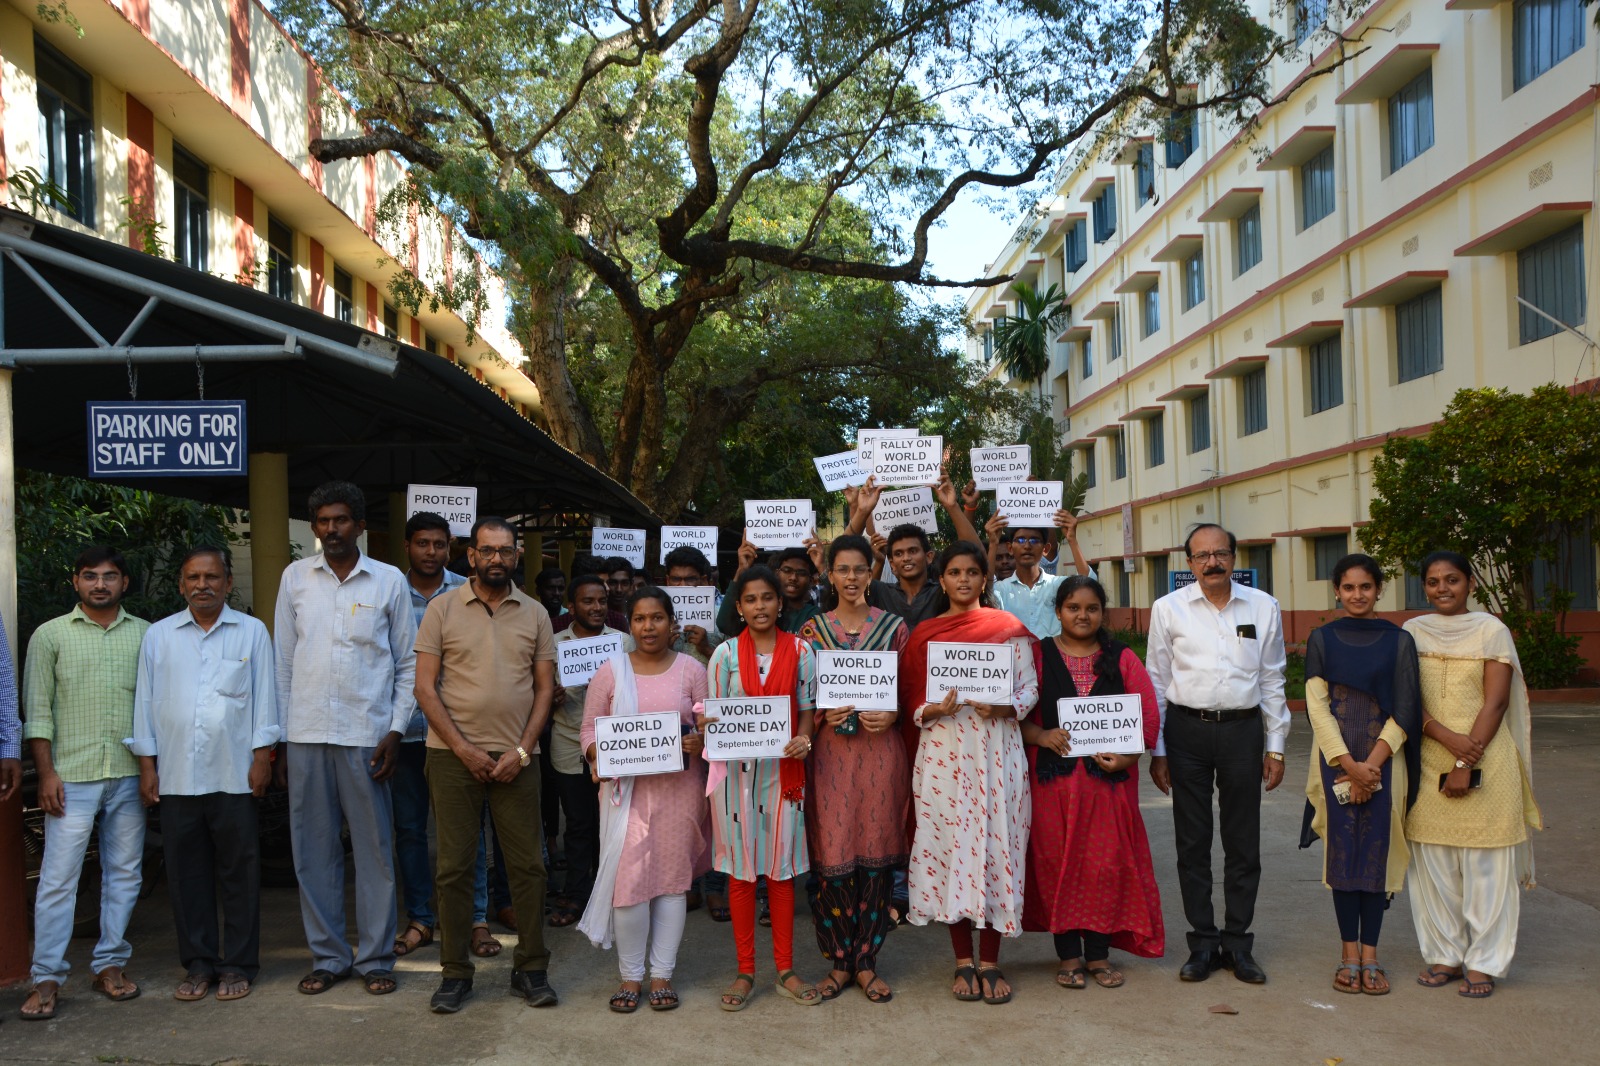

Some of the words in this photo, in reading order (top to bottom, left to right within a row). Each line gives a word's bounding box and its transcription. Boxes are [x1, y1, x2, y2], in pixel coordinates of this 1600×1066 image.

[97, 414, 192, 438] PARKING
[200, 414, 237, 437] FOR
[880, 440, 914, 449] RALLY
[916, 440, 932, 448] ON
[97, 442, 166, 465] STAFF
[179, 441, 236, 465] ONLY
[884, 452, 926, 461] WORLD
[982, 452, 1017, 460] WORLD
[821, 456, 858, 470] PROTEC
[876, 464, 914, 473] OZONE
[918, 463, 940, 472] DAY
[974, 464, 1006, 472] OZONE
[1010, 463, 1027, 471] DAY
[824, 470, 848, 481] OZONE
[881, 474, 918, 482] September
[1010, 486, 1048, 494] WORLD
[414, 494, 471, 506] PROTECT
[882, 493, 920, 506] WORLD
[757, 506, 796, 514] WORLD
[874, 508, 910, 521] OZONE
[913, 504, 933, 515] DAY
[444, 512, 472, 523] LAYER
[746, 519, 783, 528] OZONE
[788, 519, 808, 527] DAY
[603, 532, 634, 540] WORLD
[594, 543, 623, 551] OZONE
[626, 544, 642, 552] DAY
[672, 596, 710, 604] OTECT
[686, 611, 712, 620] LAYER
[564, 642, 618, 658] PROTECT
[944, 650, 995, 662] WORLD
[563, 662, 592, 674] OZONE
[833, 658, 882, 668] WORLD
[930, 666, 978, 678] OZONE
[982, 668, 1009, 679] DAY
[820, 674, 865, 685] OZONE
[870, 674, 896, 686] DAY
[939, 684, 984, 693] September
[828, 692, 873, 700] September
[720, 704, 772, 716] WORLD
[1074, 702, 1123, 714] WORLD
[612, 720, 662, 733] WORLD
[708, 722, 756, 734] OZONE
[760, 721, 786, 732] DAY
[1062, 720, 1108, 731] OZONE
[1113, 718, 1138, 729] DAY
[600, 738, 647, 752] OZONE
[651, 736, 677, 748] DAY
[717, 740, 763, 749] September
[766, 738, 780, 747] 16th
[1072, 737, 1116, 746] September
[610, 756, 654, 766] September
[656, 753, 672, 762] 16th
